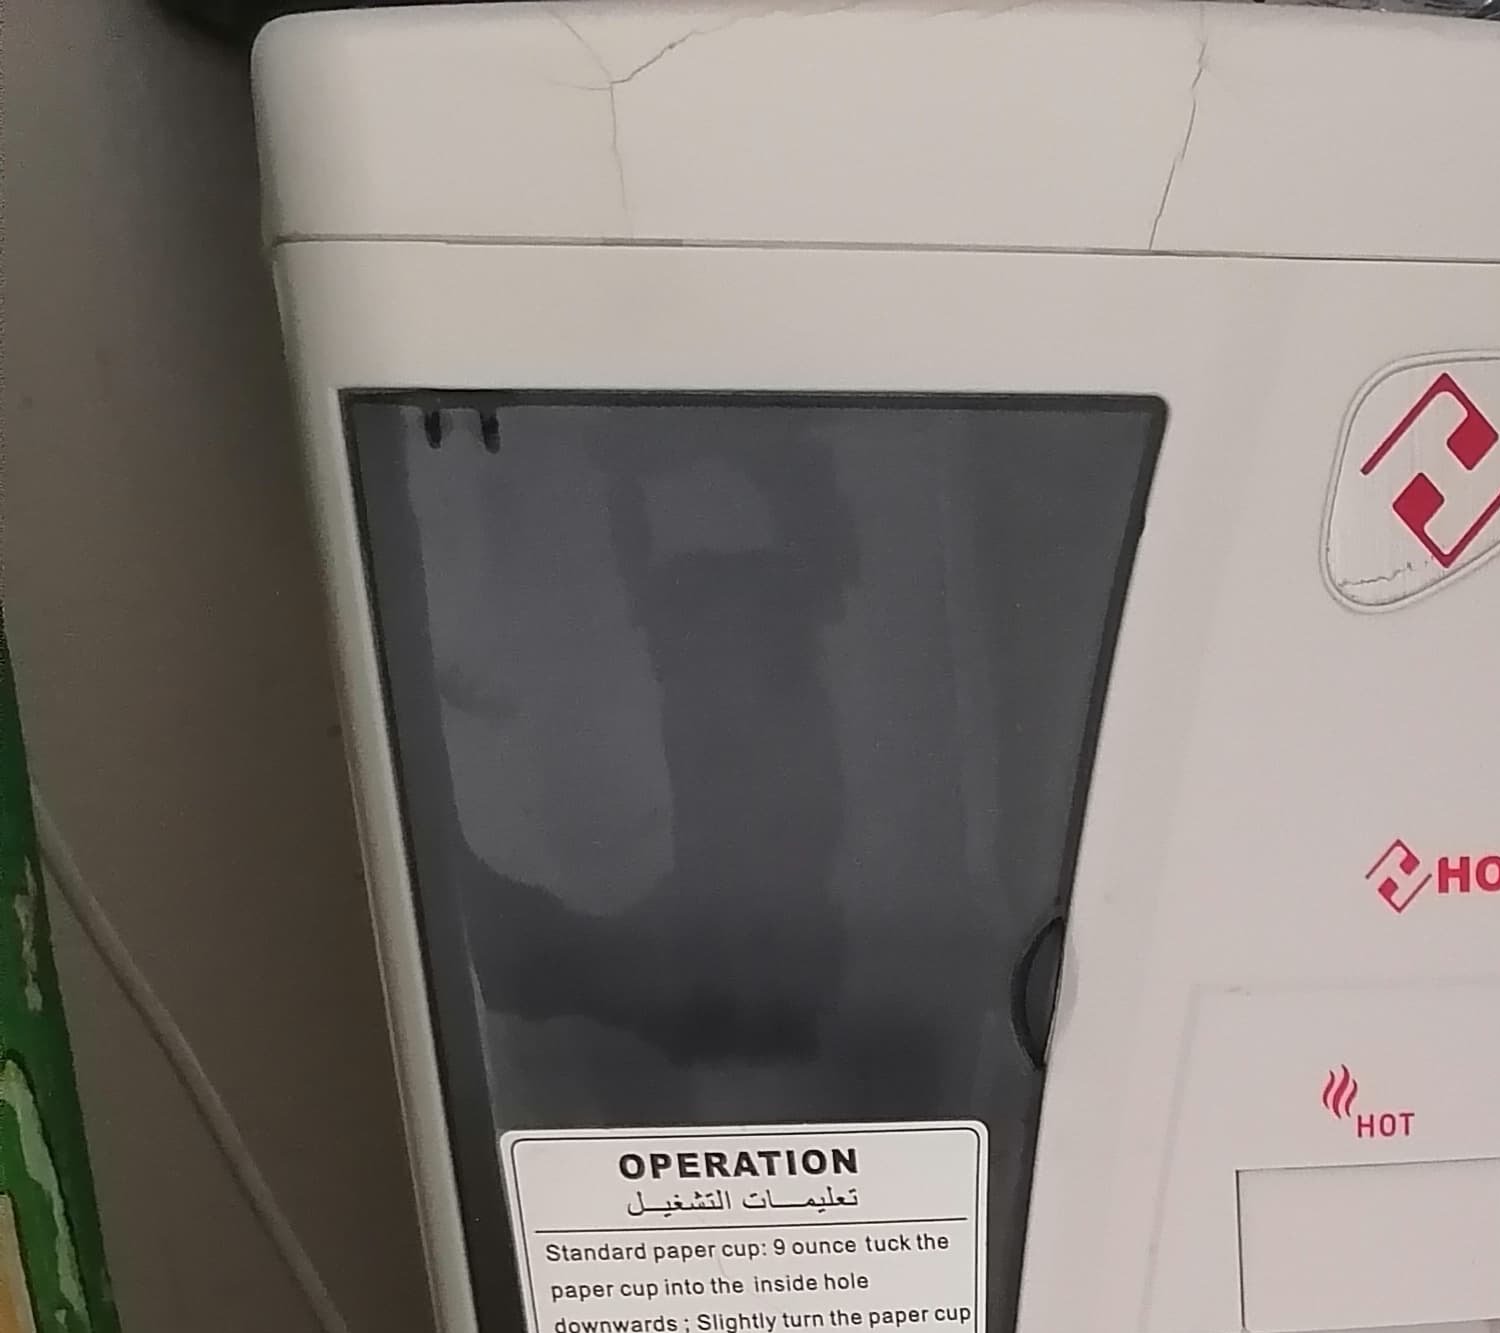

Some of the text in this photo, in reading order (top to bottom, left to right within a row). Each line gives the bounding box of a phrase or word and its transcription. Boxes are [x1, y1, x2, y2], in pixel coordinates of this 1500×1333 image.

[1357, 1112, 1416, 1139] HOT
[618, 1147, 859, 1180] OPERATION
[545, 1232, 949, 1264] Standard paper cup: 9 ounce tuck the
[550, 1271, 869, 1304] paper cup into the inside hole
[781, 1312, 825, 1329] turn
[829, 1309, 863, 1327] the
[868, 1309, 930, 1329] paper
[934, 1307, 972, 1325] cup
